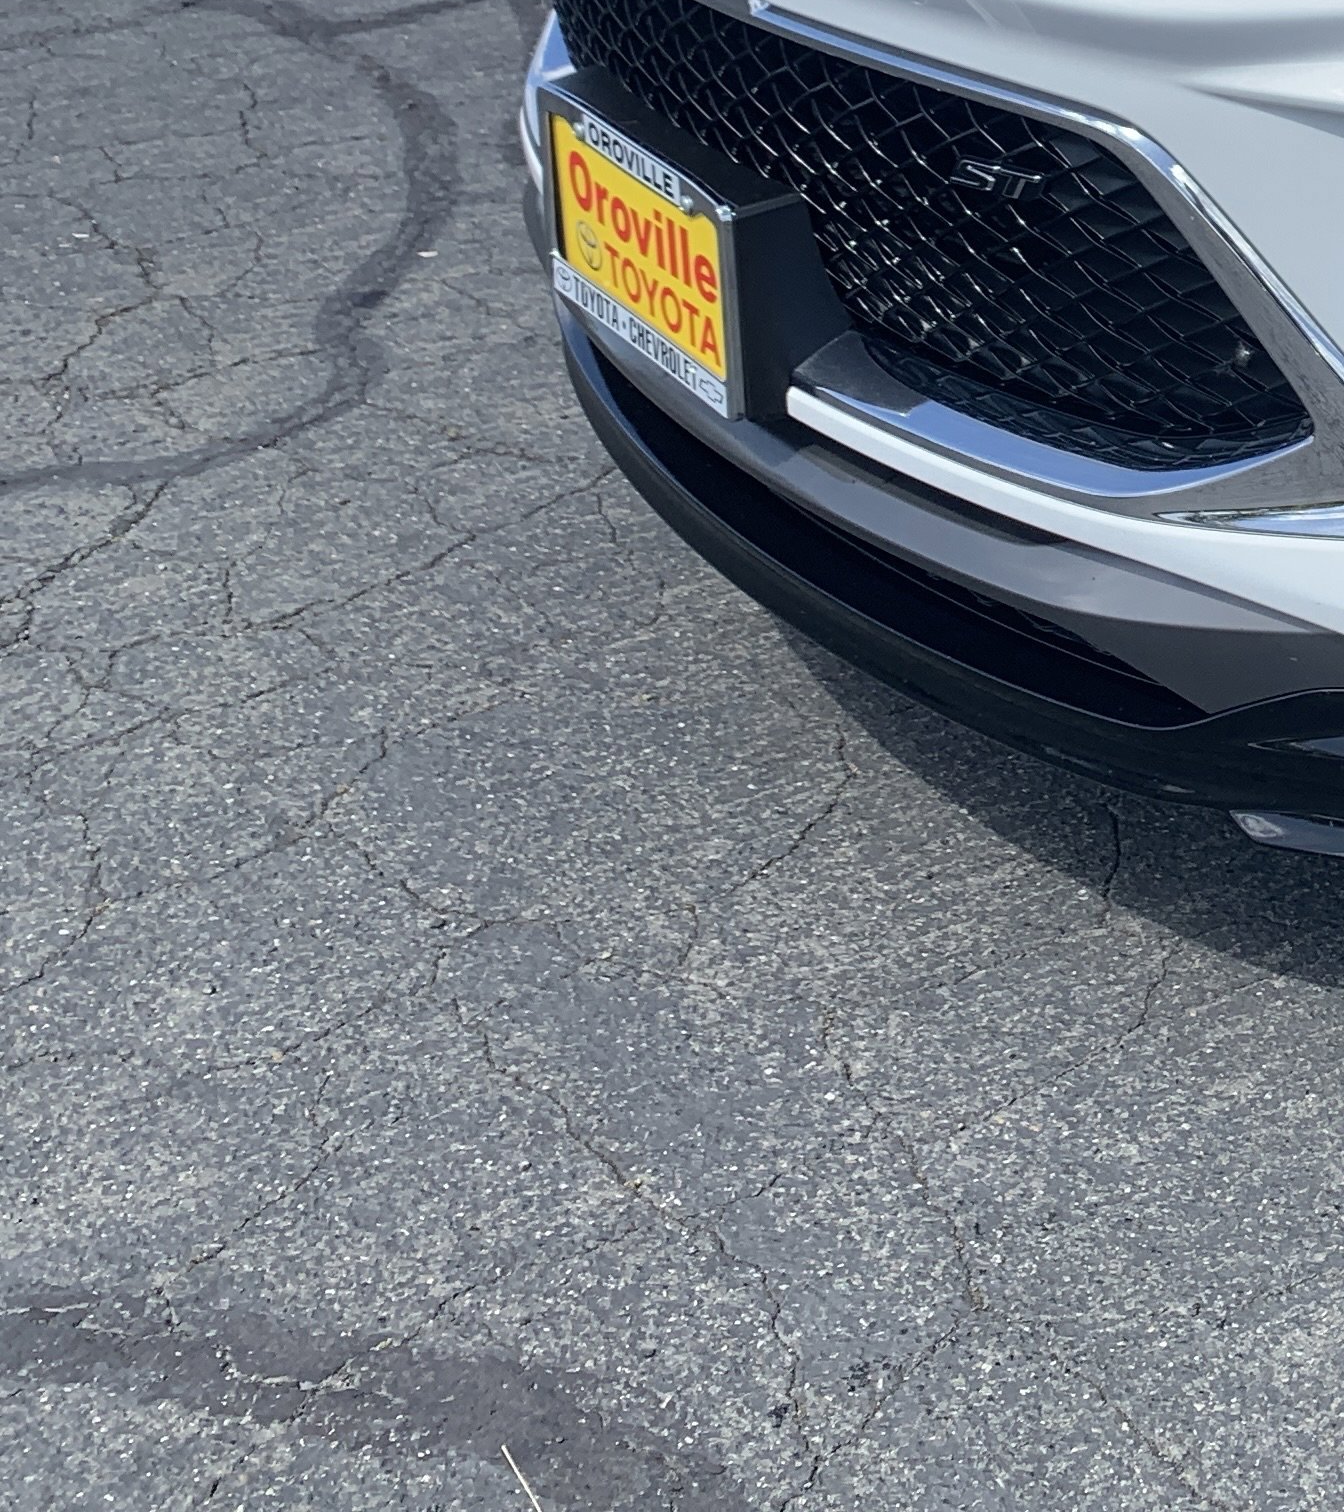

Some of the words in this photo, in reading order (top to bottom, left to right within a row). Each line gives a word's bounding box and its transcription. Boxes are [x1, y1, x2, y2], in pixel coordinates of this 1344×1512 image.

[589, 126, 674, 198] OROVILLE
[569, 150, 718, 304] Oroville
[573, 275, 620, 328] TOYOTA
[629, 316, 697, 391] CHEVROLET
[603, 241, 721, 368] TOYOTA
